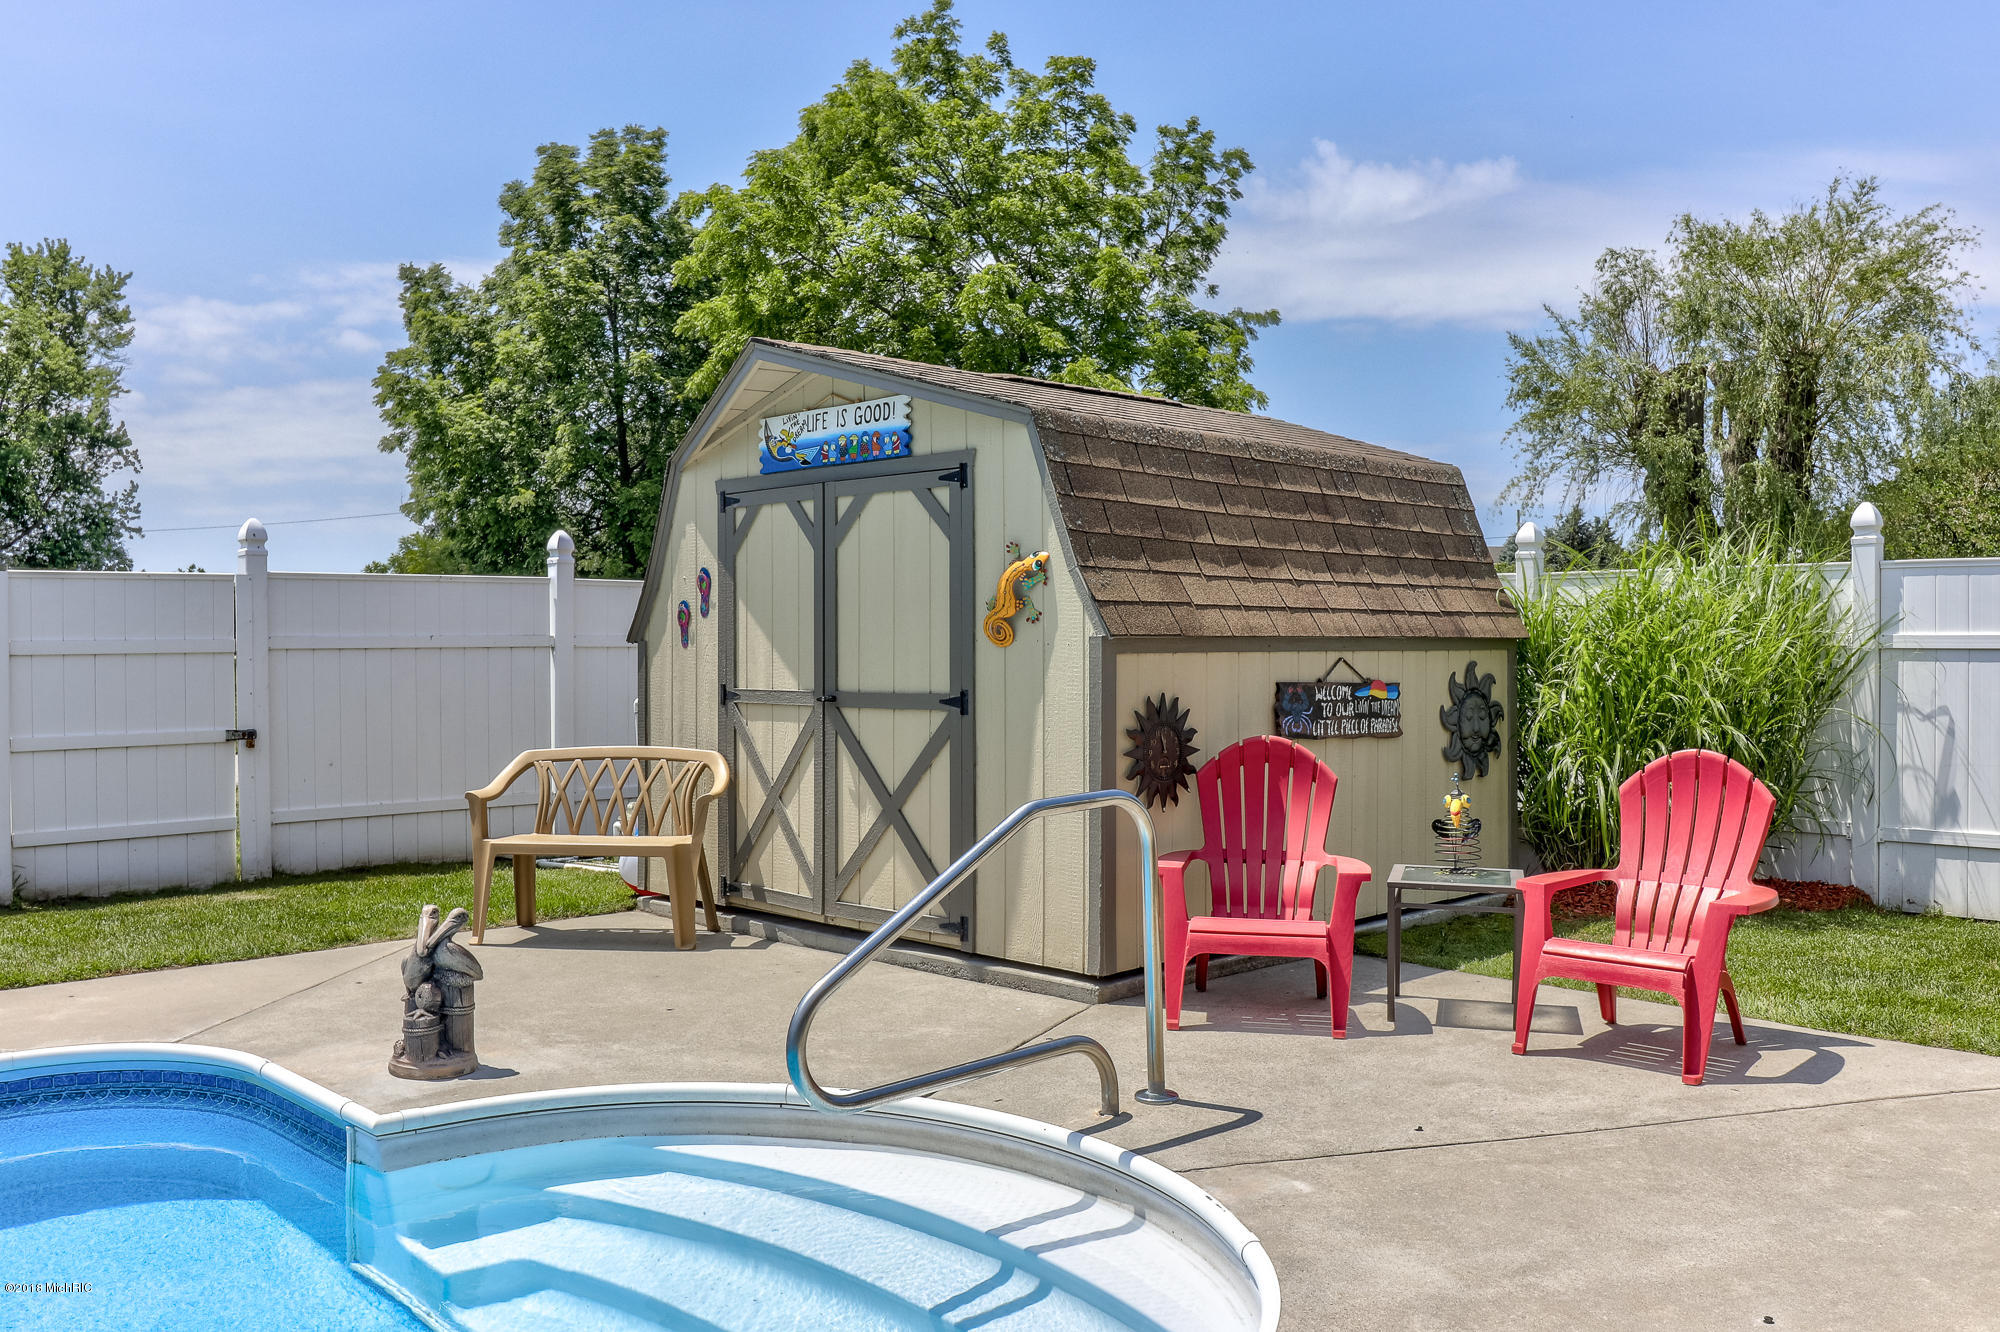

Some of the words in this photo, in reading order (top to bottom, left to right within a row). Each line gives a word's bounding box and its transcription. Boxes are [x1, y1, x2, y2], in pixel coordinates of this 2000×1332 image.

[790, 420, 800, 429] THE
[806, 411, 828, 433] LIFE
[836, 408, 847, 427] IS
[854, 401, 896, 426] GOOD!
[1315, 685, 1353, 701] WELCOME
[1321, 702, 1333, 717] TO
[1336, 702, 1354, 717] OUR
[1371, 701, 1381, 713] THE
[1313, 720, 1339, 736] LITTLE
[1341, 718, 1360, 736] PIECE
[1361, 717, 1369, 734] OF
